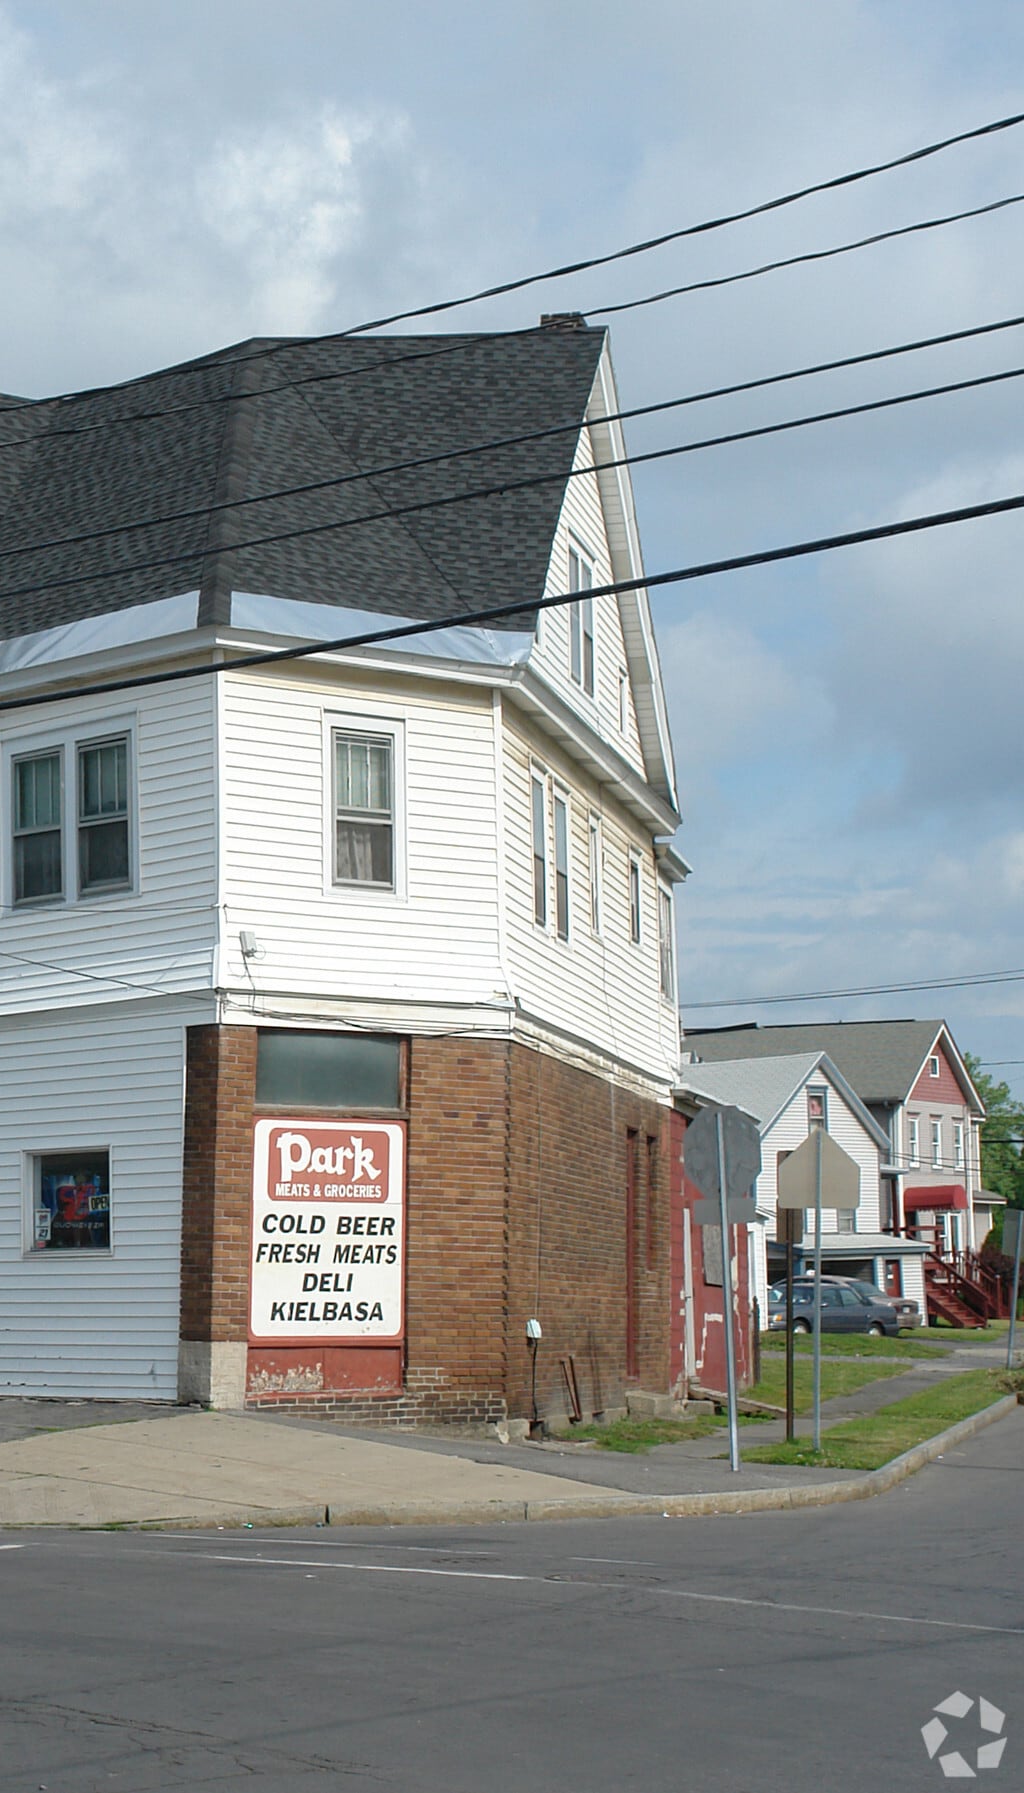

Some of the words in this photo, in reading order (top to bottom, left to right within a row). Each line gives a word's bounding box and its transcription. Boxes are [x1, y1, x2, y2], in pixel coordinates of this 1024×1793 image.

[276, 1132, 382, 1183] Park
[275, 1183, 310, 1197] MEATS
[313, 1184, 321, 1197] &
[324, 1184, 382, 1199] GROCERIES
[262, 1213, 326, 1235] COLD
[336, 1216, 396, 1237] BEER
[256, 1243, 321, 1264] FRESH
[333, 1244, 398, 1265] MEATS
[302, 1273, 354, 1293] DELI
[270, 1302, 384, 1322] KIELBASA
